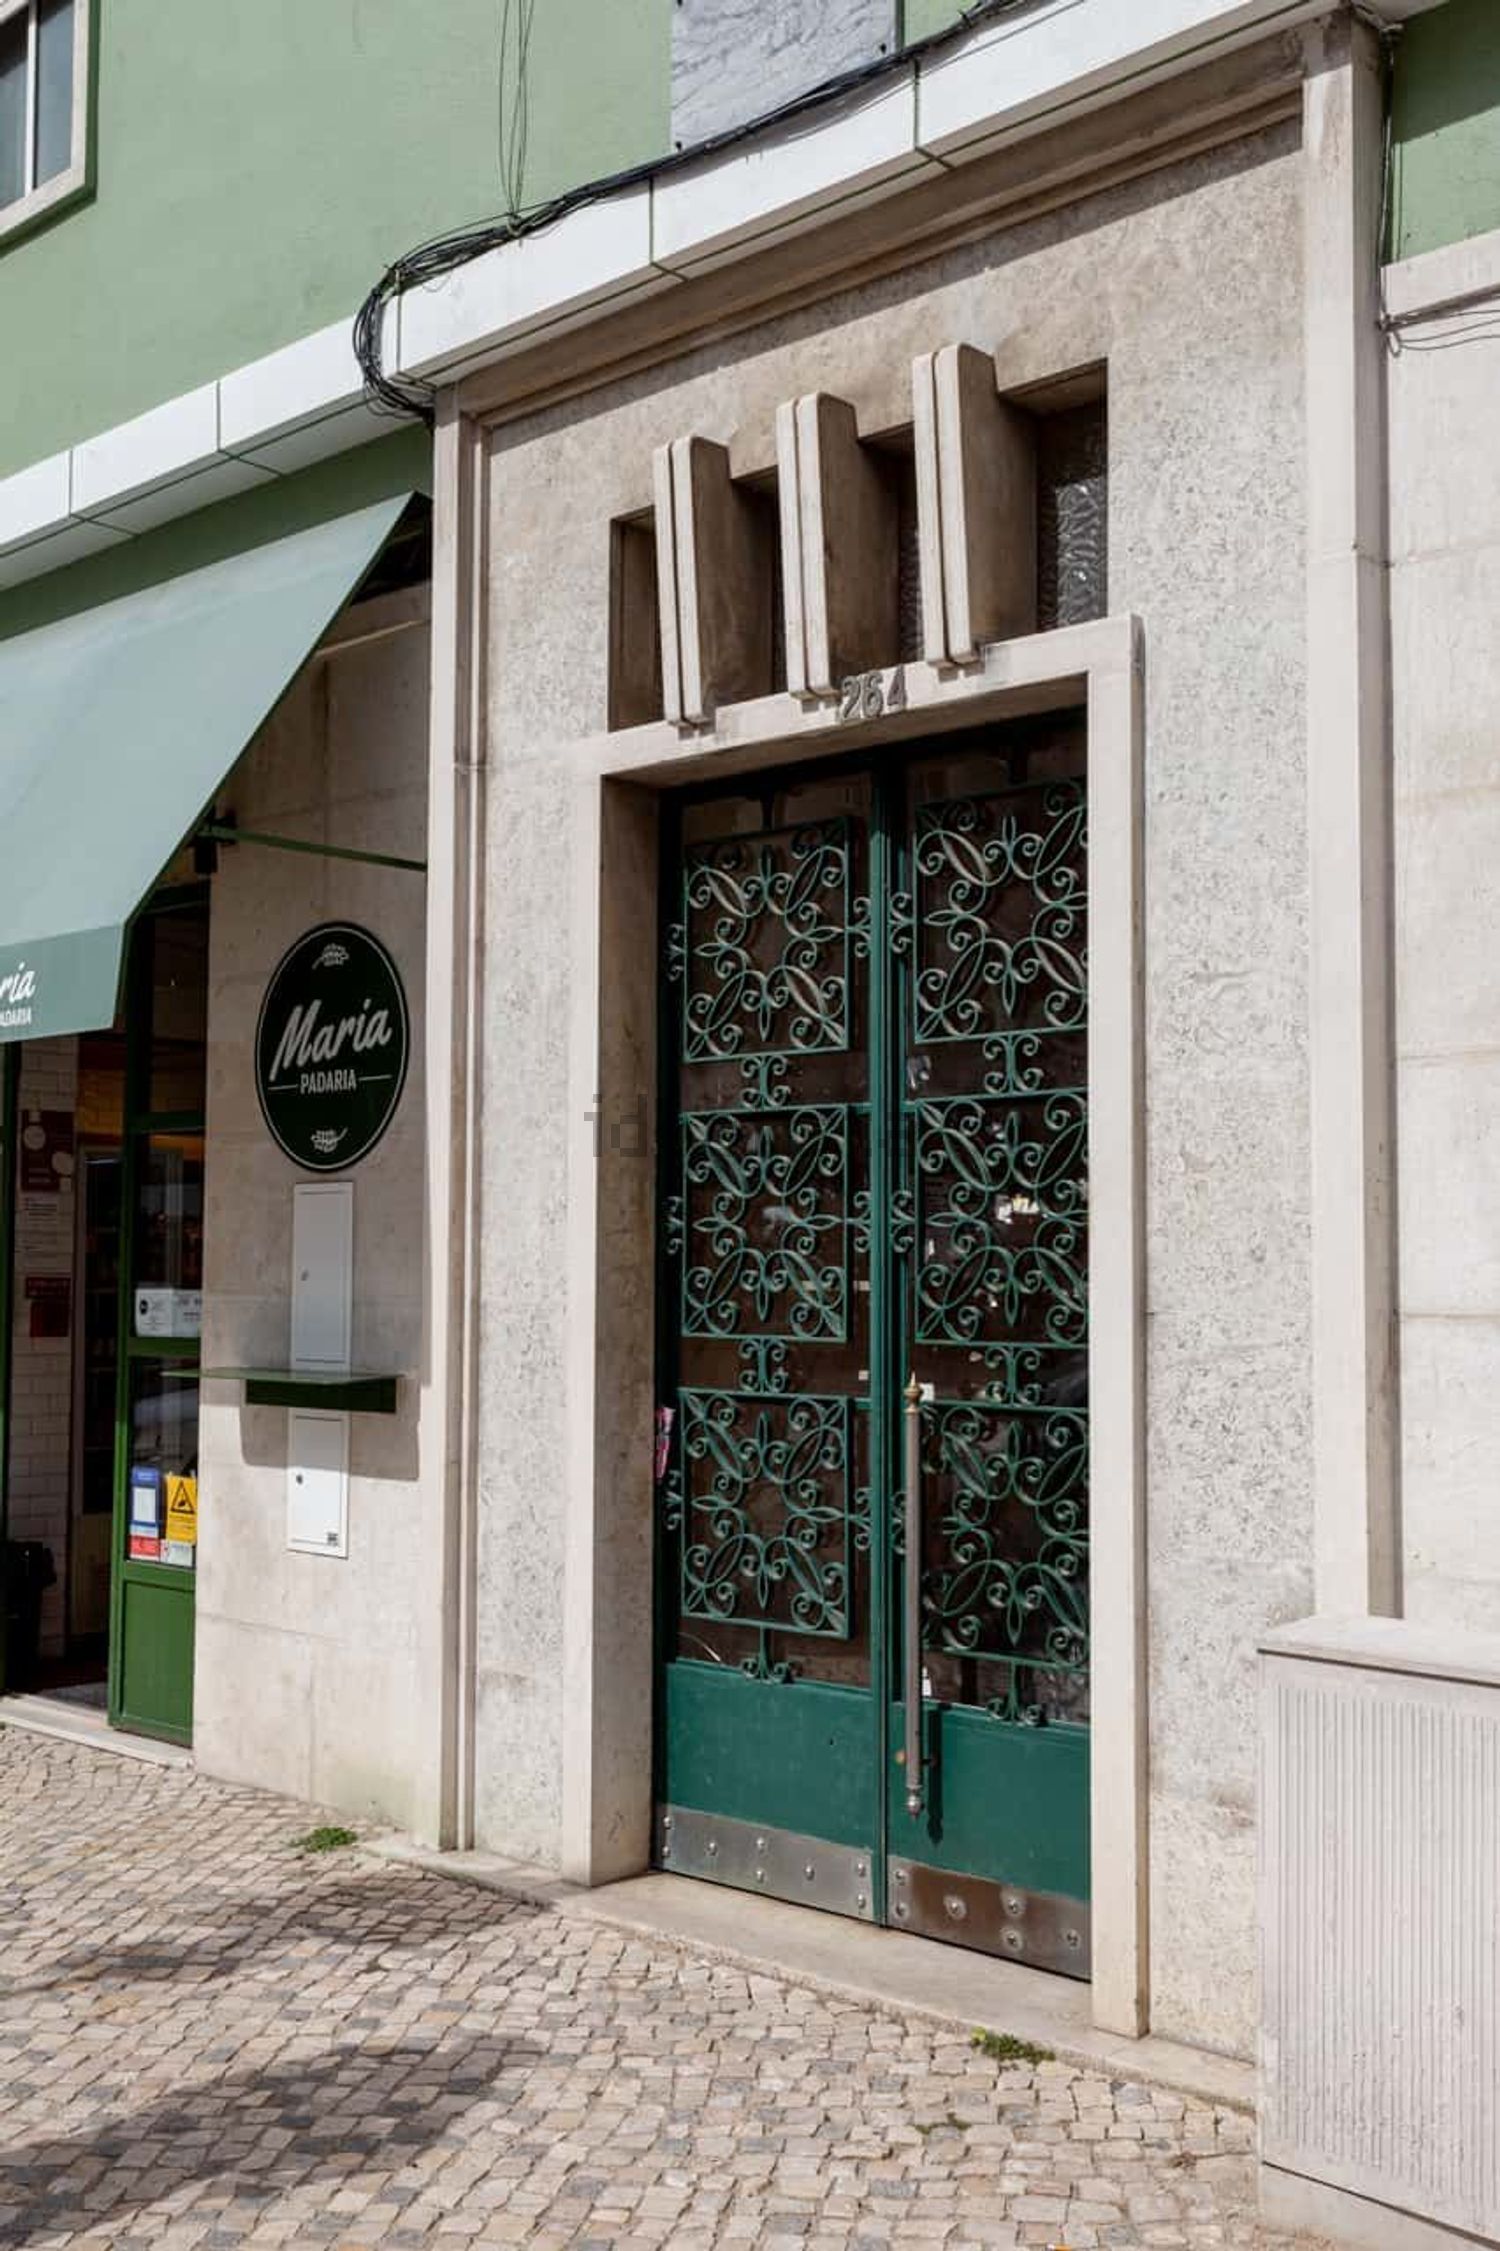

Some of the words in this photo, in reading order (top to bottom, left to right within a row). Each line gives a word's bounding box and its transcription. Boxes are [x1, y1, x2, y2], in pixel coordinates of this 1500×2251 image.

[841, 664, 907, 720] 264
[269, 998, 393, 1081] Maria
[300, 1067, 357, 1095] PADARIA
